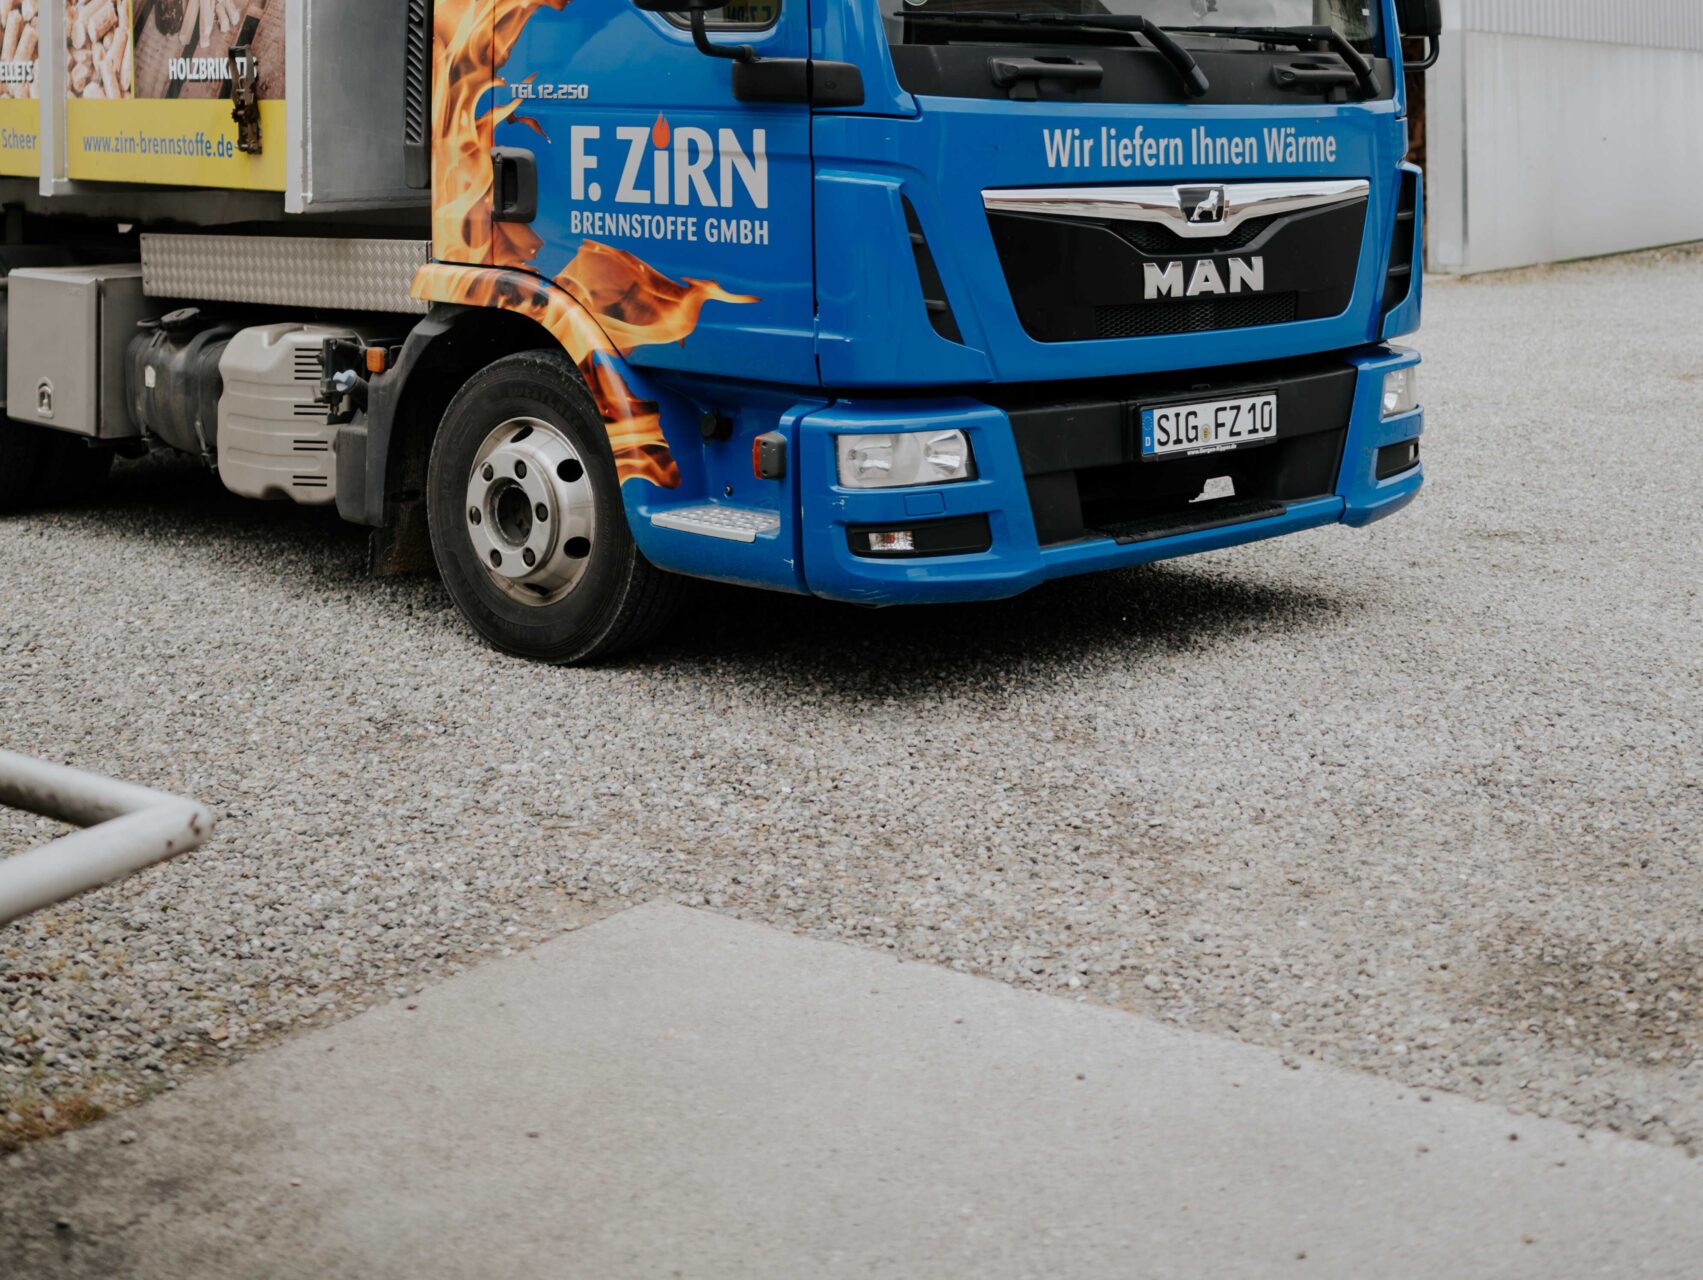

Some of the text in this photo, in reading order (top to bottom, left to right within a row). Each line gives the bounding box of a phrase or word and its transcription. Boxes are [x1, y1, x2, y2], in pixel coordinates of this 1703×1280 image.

[510, 84, 589, 100] TGL 12.250
[2, 128, 37, 151] Scheer
[83, 130, 233, 158] www.zirn-brennstoffe.de
[1043, 125, 1337, 168] Wir liefern Ihnen Wärme
[571, 125, 602, 202] F.
[571, 211, 768, 245] BRENNSTOFFE GMBH
[1143, 256, 1265, 300] MAN
[1157, 410, 1199, 447] SIG
